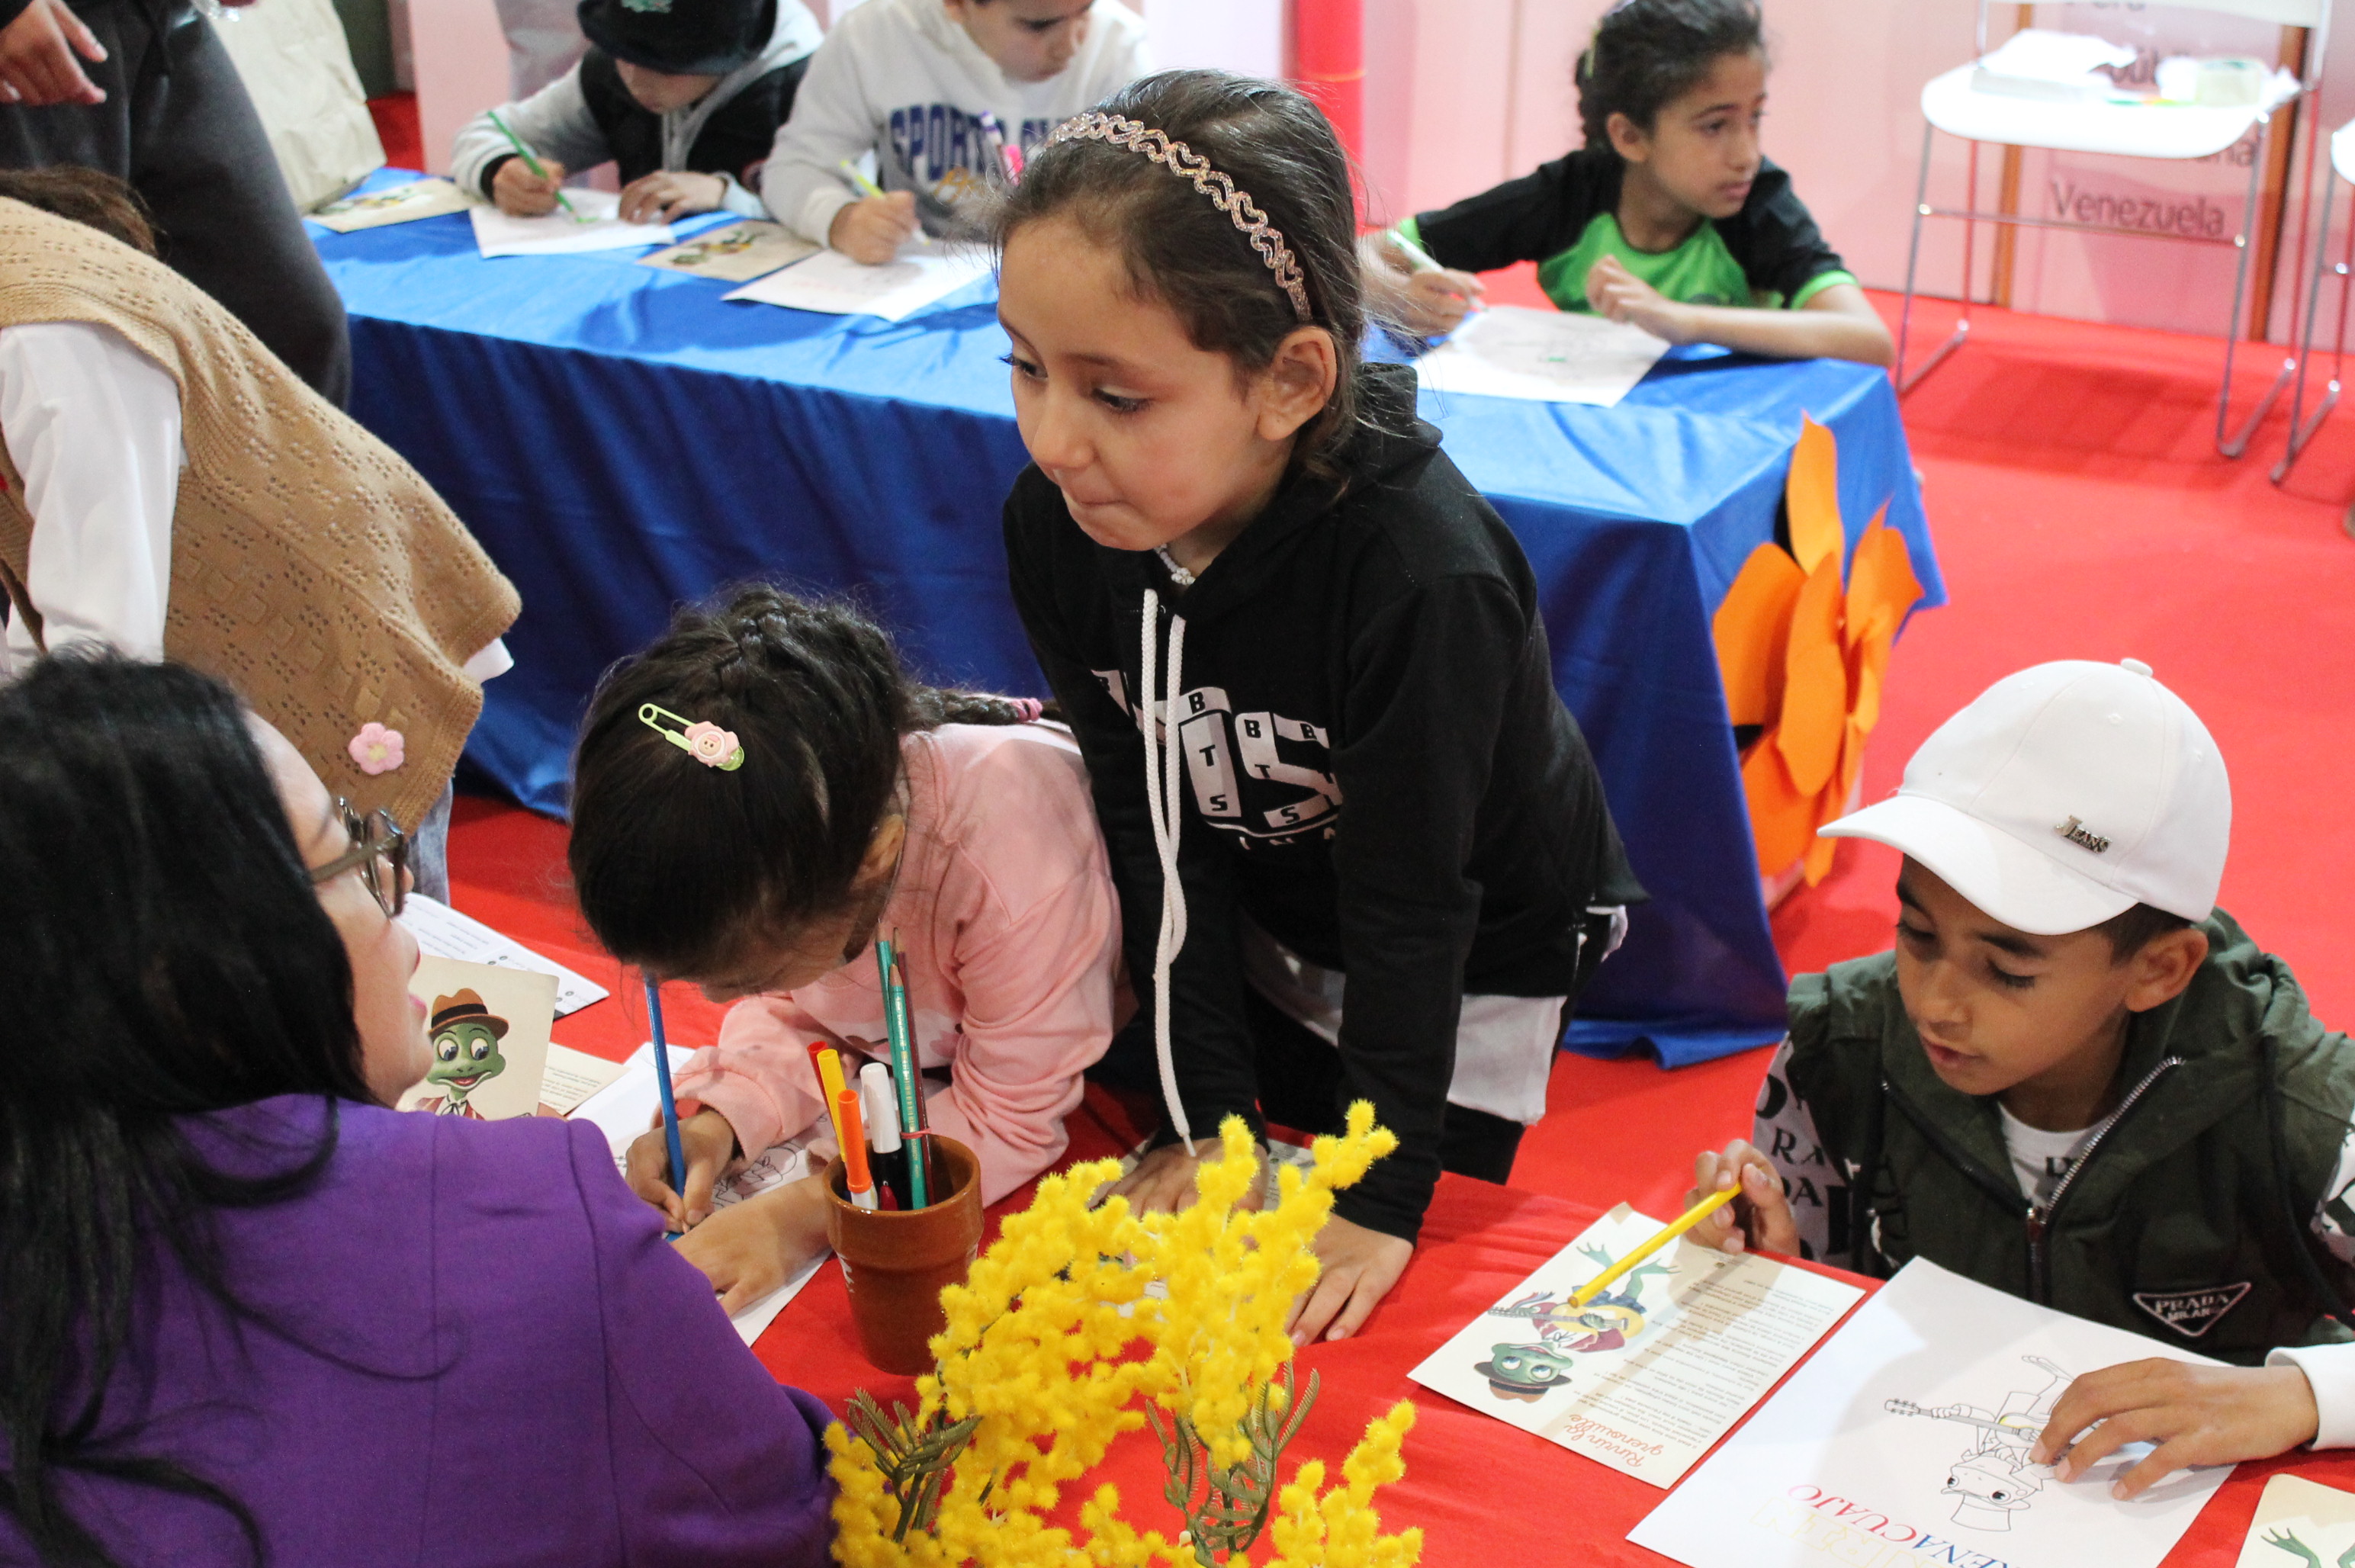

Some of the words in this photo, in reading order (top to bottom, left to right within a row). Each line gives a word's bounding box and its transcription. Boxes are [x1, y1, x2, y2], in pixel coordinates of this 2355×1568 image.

[2051, 177, 2225, 237] Venezuela
[2155, 1295, 2228, 1315] PRADA
[1563, 1425, 1586, 1441] la
[1569, 1414, 1664, 1455] grenouille
[1788, 1483, 2022, 1568] ENACUAJO
